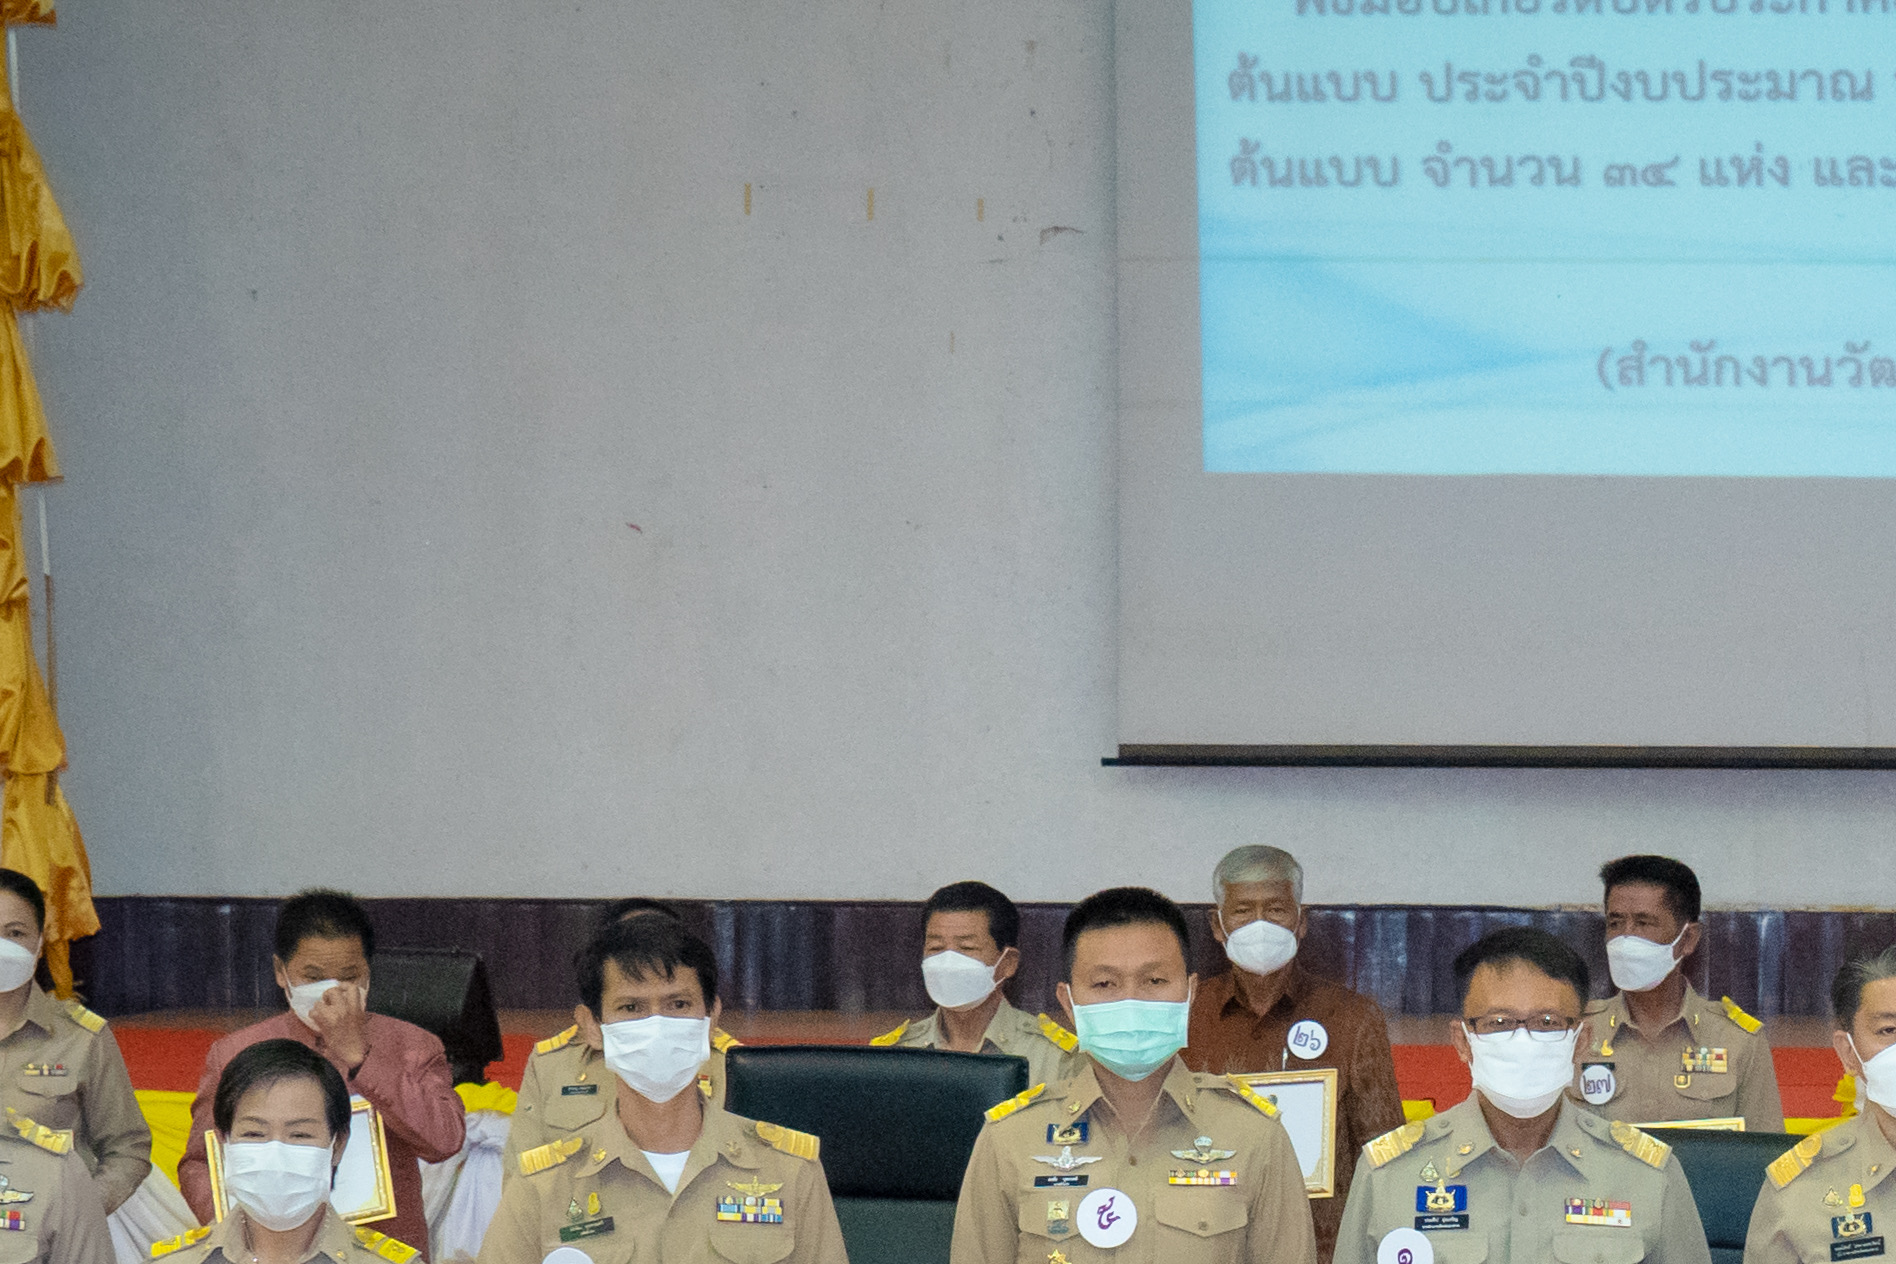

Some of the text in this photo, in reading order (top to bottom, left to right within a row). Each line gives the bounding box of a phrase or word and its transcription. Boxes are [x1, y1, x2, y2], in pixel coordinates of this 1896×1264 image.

[1228, 52, 1398, 103] ต้นแบบ
[1419, 54, 1875, 103] ประจำปีงบประมาณ
[1230, 138, 1400, 188] ต้นแบบ
[1422, 140, 1582, 188] จำนวน
[1603, 155, 1680, 188] ๓๔
[1699, 141, 1791, 188] แห่ง
[1293, 1025, 1322, 1051] ๒๖
